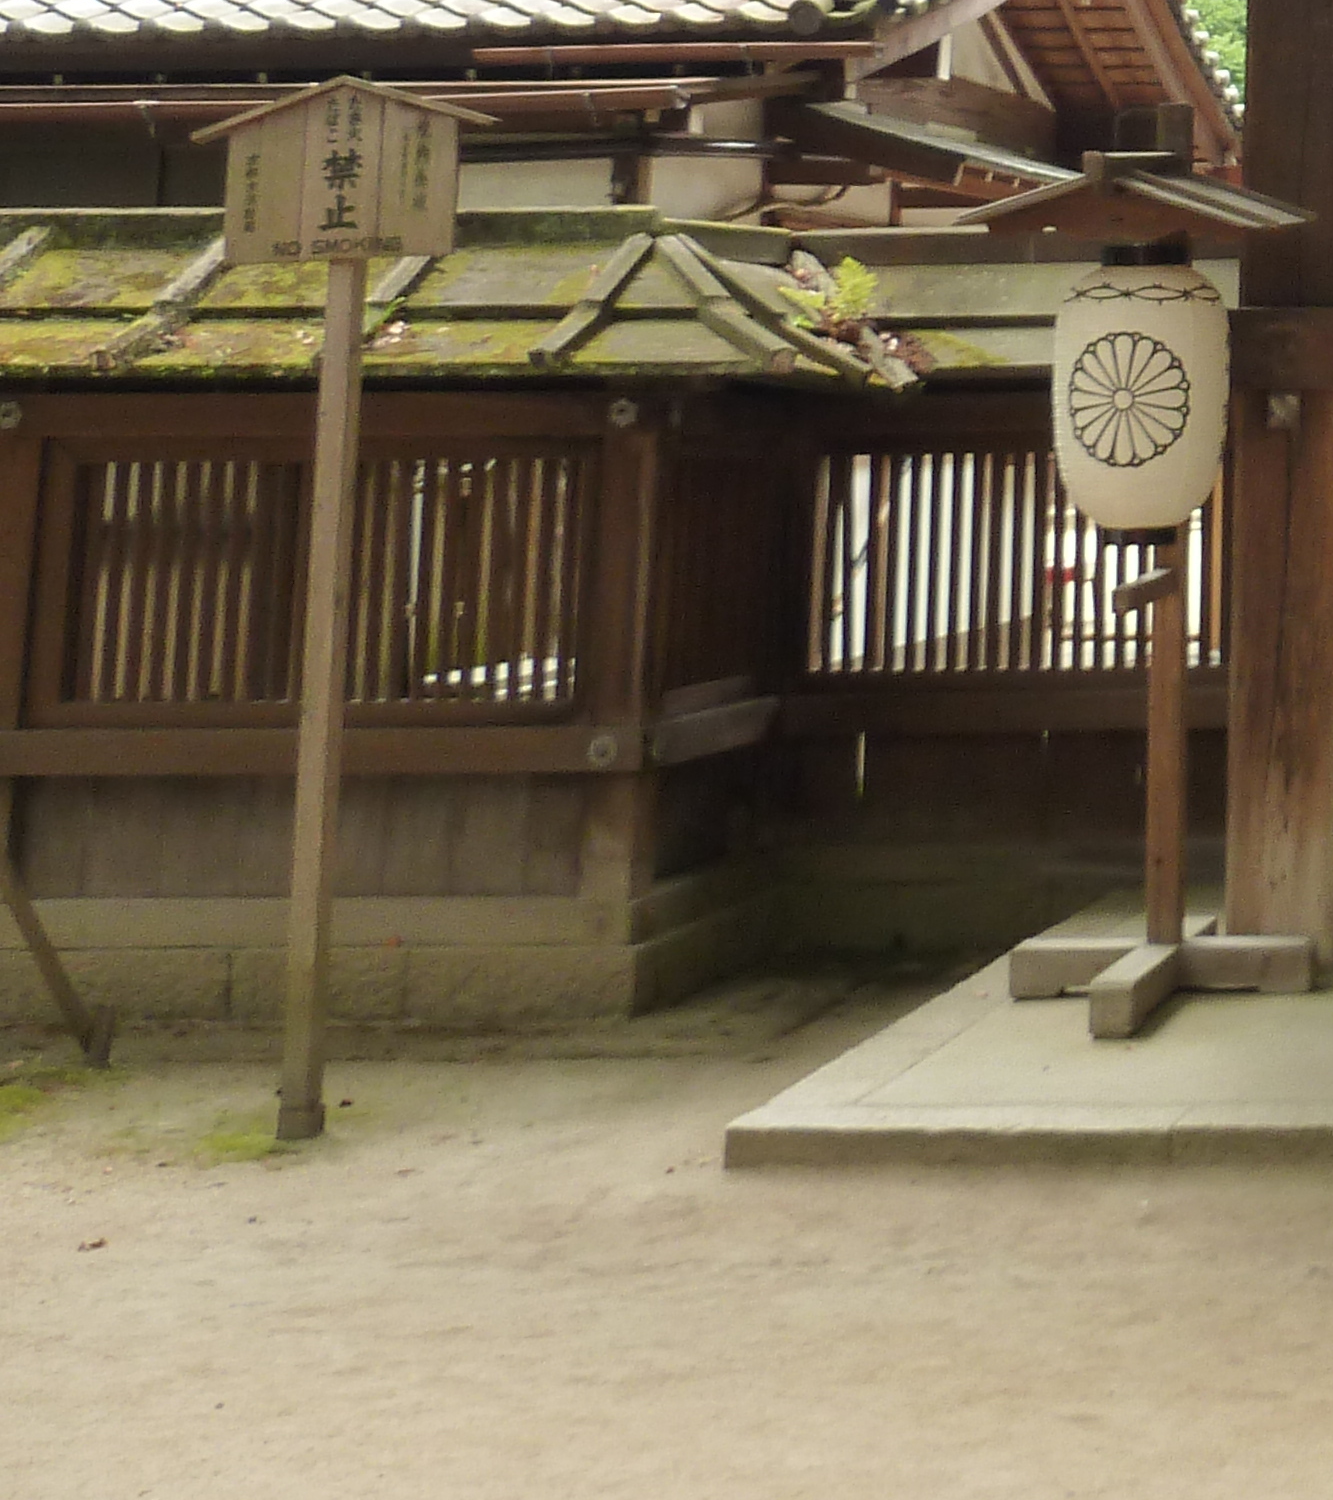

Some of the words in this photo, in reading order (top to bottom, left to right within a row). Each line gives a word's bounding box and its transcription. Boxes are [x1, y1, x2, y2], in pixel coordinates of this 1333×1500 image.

[318, 148, 364, 231] 禁止
[272, 240, 302, 256] NO
[310, 236, 402, 254] SMOKING
